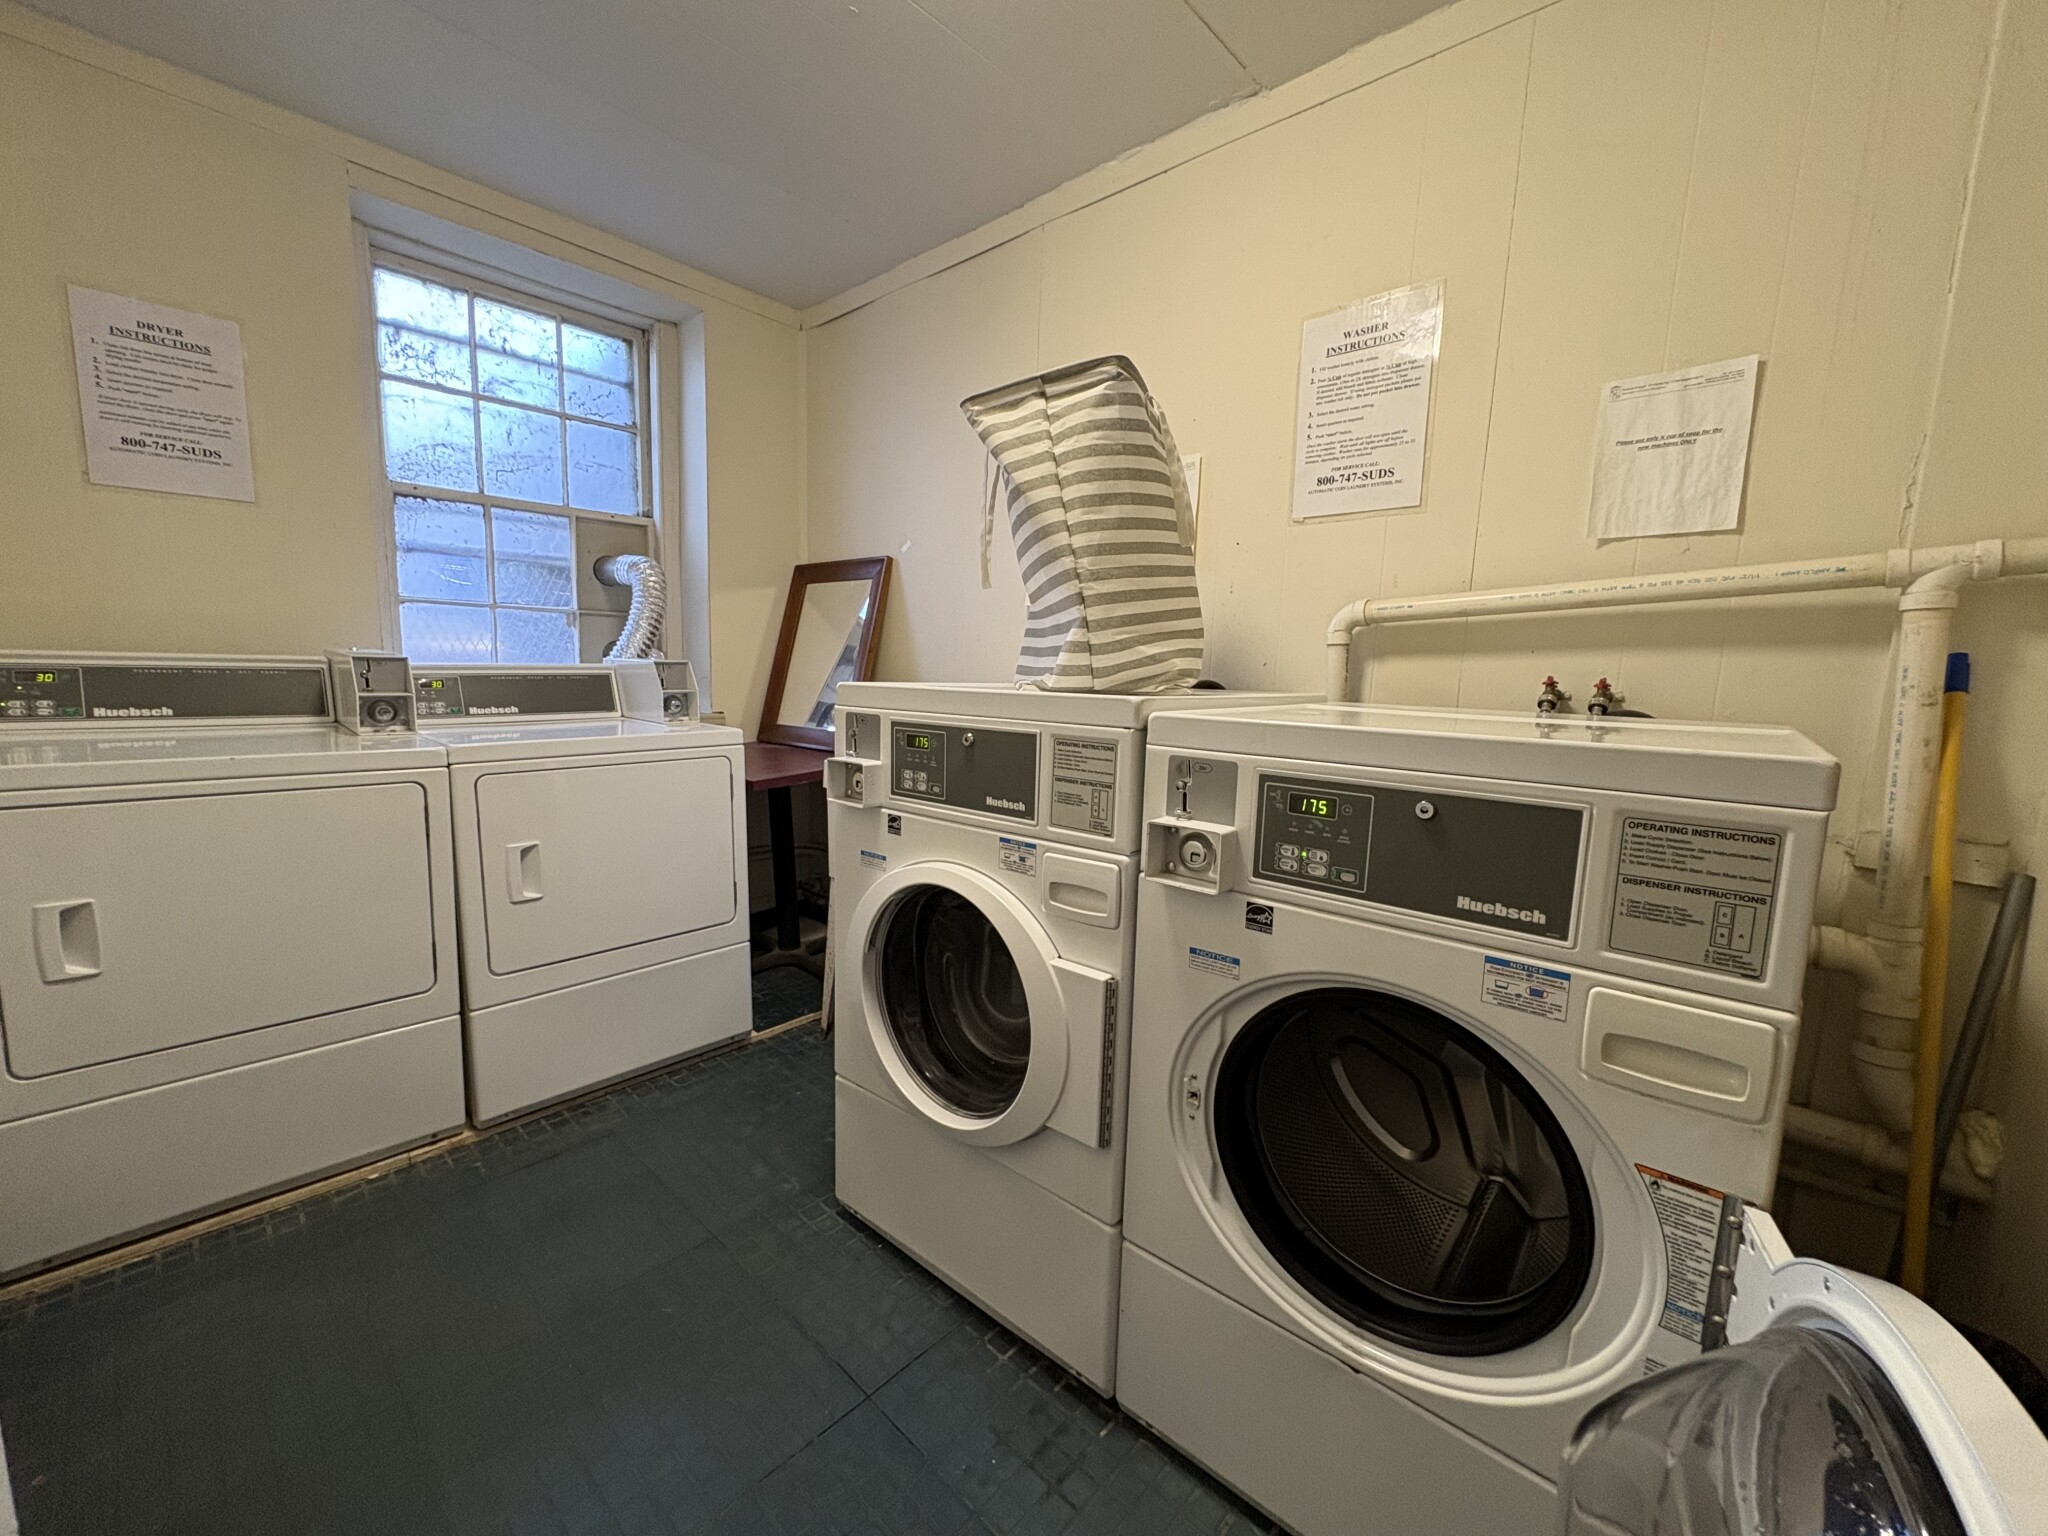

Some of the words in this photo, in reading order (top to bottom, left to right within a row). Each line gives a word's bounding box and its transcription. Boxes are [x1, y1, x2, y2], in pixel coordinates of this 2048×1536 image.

[137, 321, 184, 338] DRYER
[1343, 321, 1389, 340] WASHER
[108, 325, 211, 355] INSTRUCTIONS
[1326, 329, 1406, 356] INSTRUCTIONS
[1616, 439, 1634, 447] Please
[1712, 426, 1723, 434] the
[120, 436, 222, 460] 800-747-SUDS
[1342, 463, 1364, 471] SERVICE
[1316, 467, 1395, 487] 800-747-SUDS
[1308, 487, 1334, 495] AUTOMATIC
[36, 673, 54, 682] 30
[431, 680, 443, 689] 30
[93, 706, 174, 718] Huebsch
[469, 705, 519, 715] Huebsch
[915, 737, 929, 748] 175
[1082, 743, 1114, 752] INSTRUCTIONS
[986, 796, 1026, 812] Huebsch
[1302, 798, 1327, 815] 175
[1628, 821, 1689, 836] OPERATING
[1691, 828, 1776, 846] INSTRUCTIONS
[1622, 877, 1682, 892] DISPENSER
[1683, 886, 1768, 906] INSTRUCTIONS
[1456, 895, 1546, 925] Huebsch
[1195, 949, 1233, 964] NOTICE
[1509, 961, 1545, 975] NOTICE
